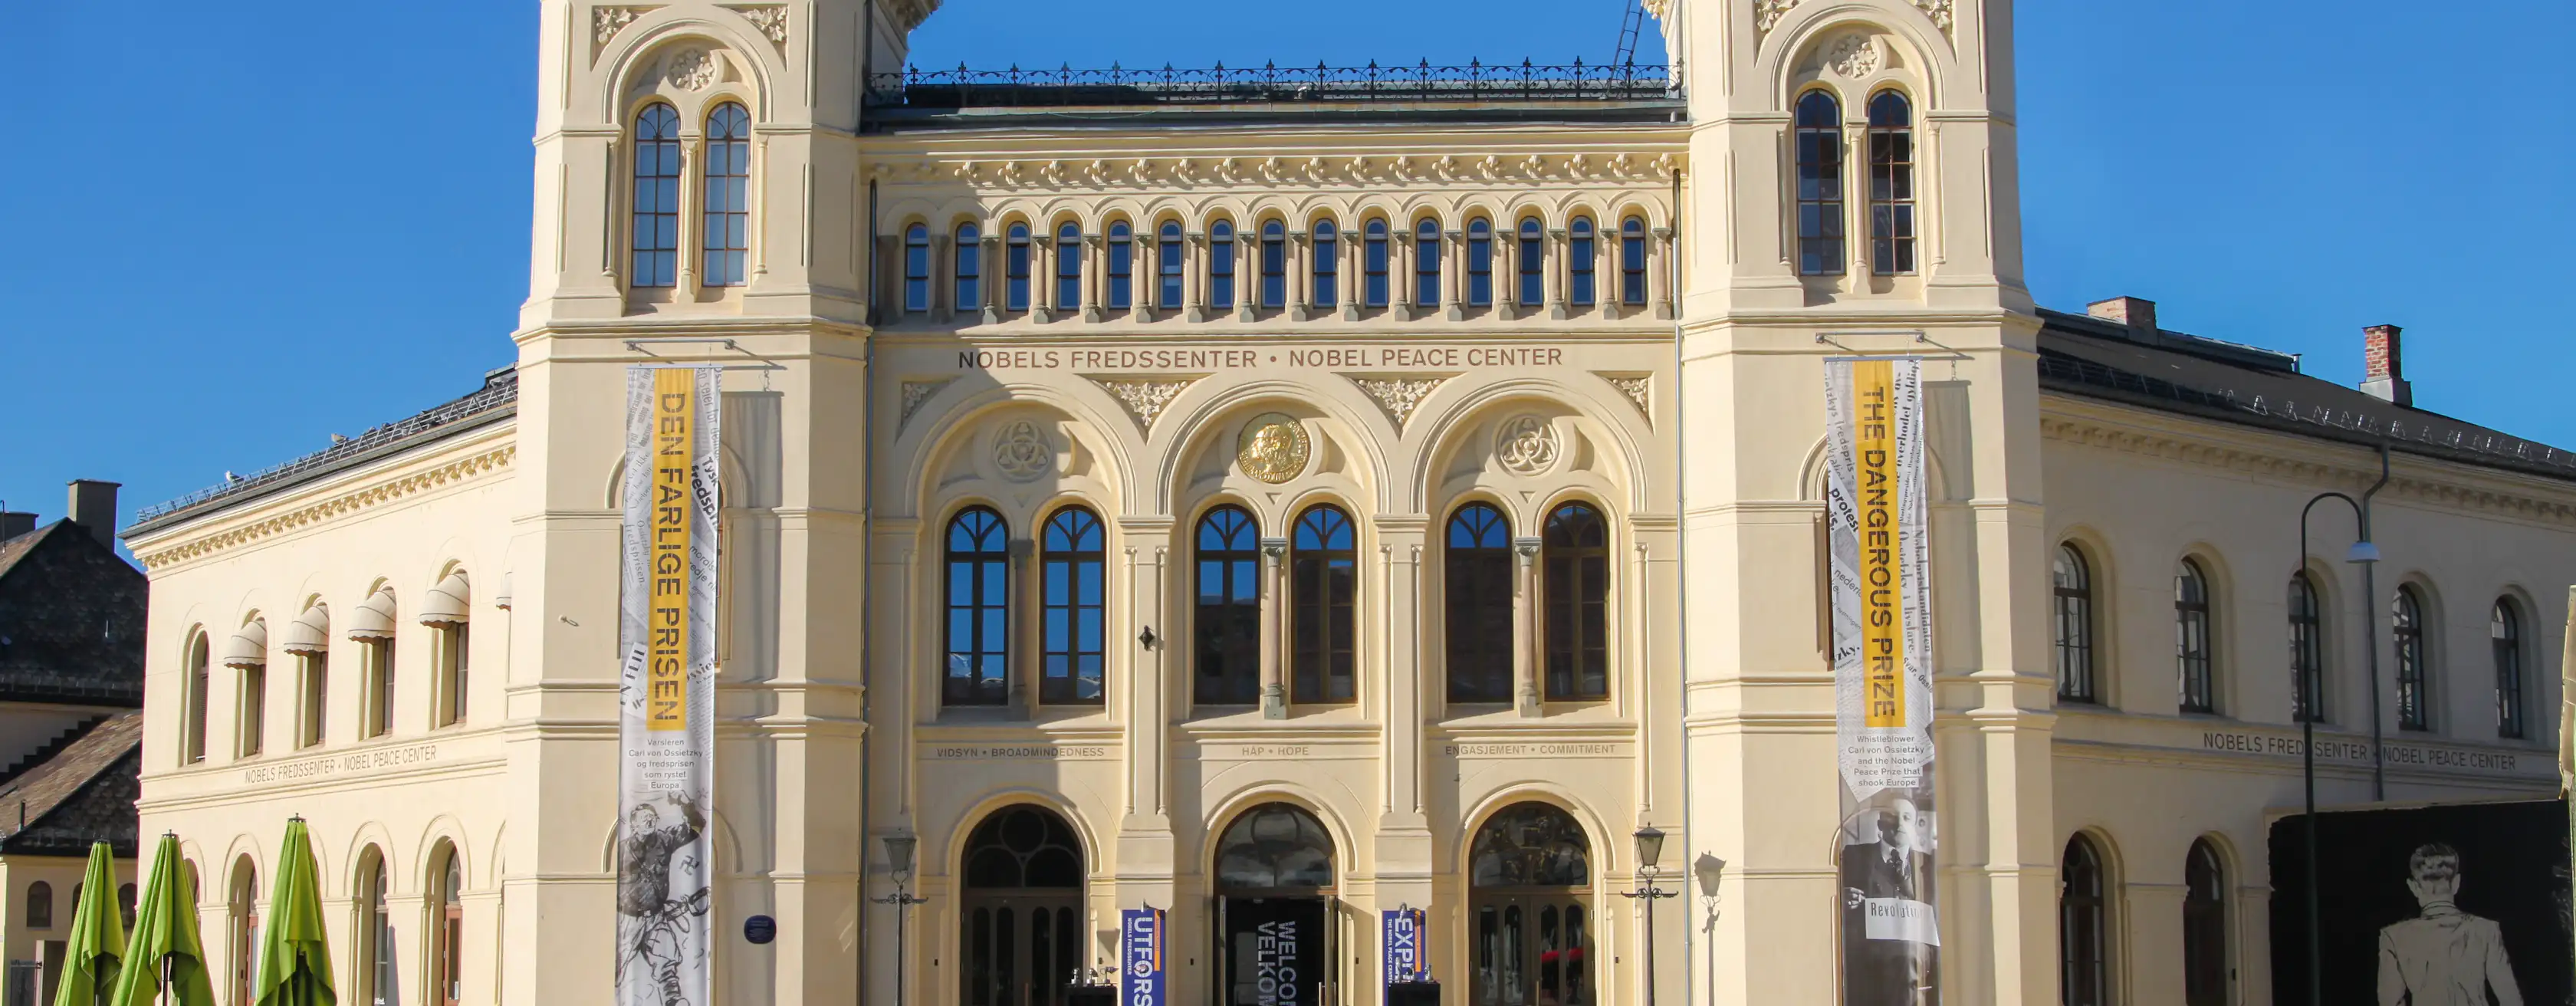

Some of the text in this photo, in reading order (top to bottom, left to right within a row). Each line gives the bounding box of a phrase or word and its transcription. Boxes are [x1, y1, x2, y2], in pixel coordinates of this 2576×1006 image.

[959, 347, 1562, 369] NOBELS FREDSSENTER NOBEL PEACE CENTER
[691, 465, 718, 529] fredspri
[655, 393, 685, 720] DEN FARLIGE PRISEN
[1863, 386, 1895, 717] THE DANGEROUS PRIZE
[245, 745, 437, 784] NOBELS FREDSSENTER NOBEL PEACE CENTER
[664, 748, 703, 758] Ossietzky
[937, 748, 1105, 757] VIDSYN BROADMINDEDNESS
[1278, 746, 1309, 755] HOPE
[1445, 745, 1616, 755] ENGASJEMENT COMMITMENT
[2203, 732, 2516, 770] NOBELS FREDSENTER NOBEL PEACE CENTER
[664, 771, 686, 779] rystet
[1278, 921, 1296, 1006] WELCO
